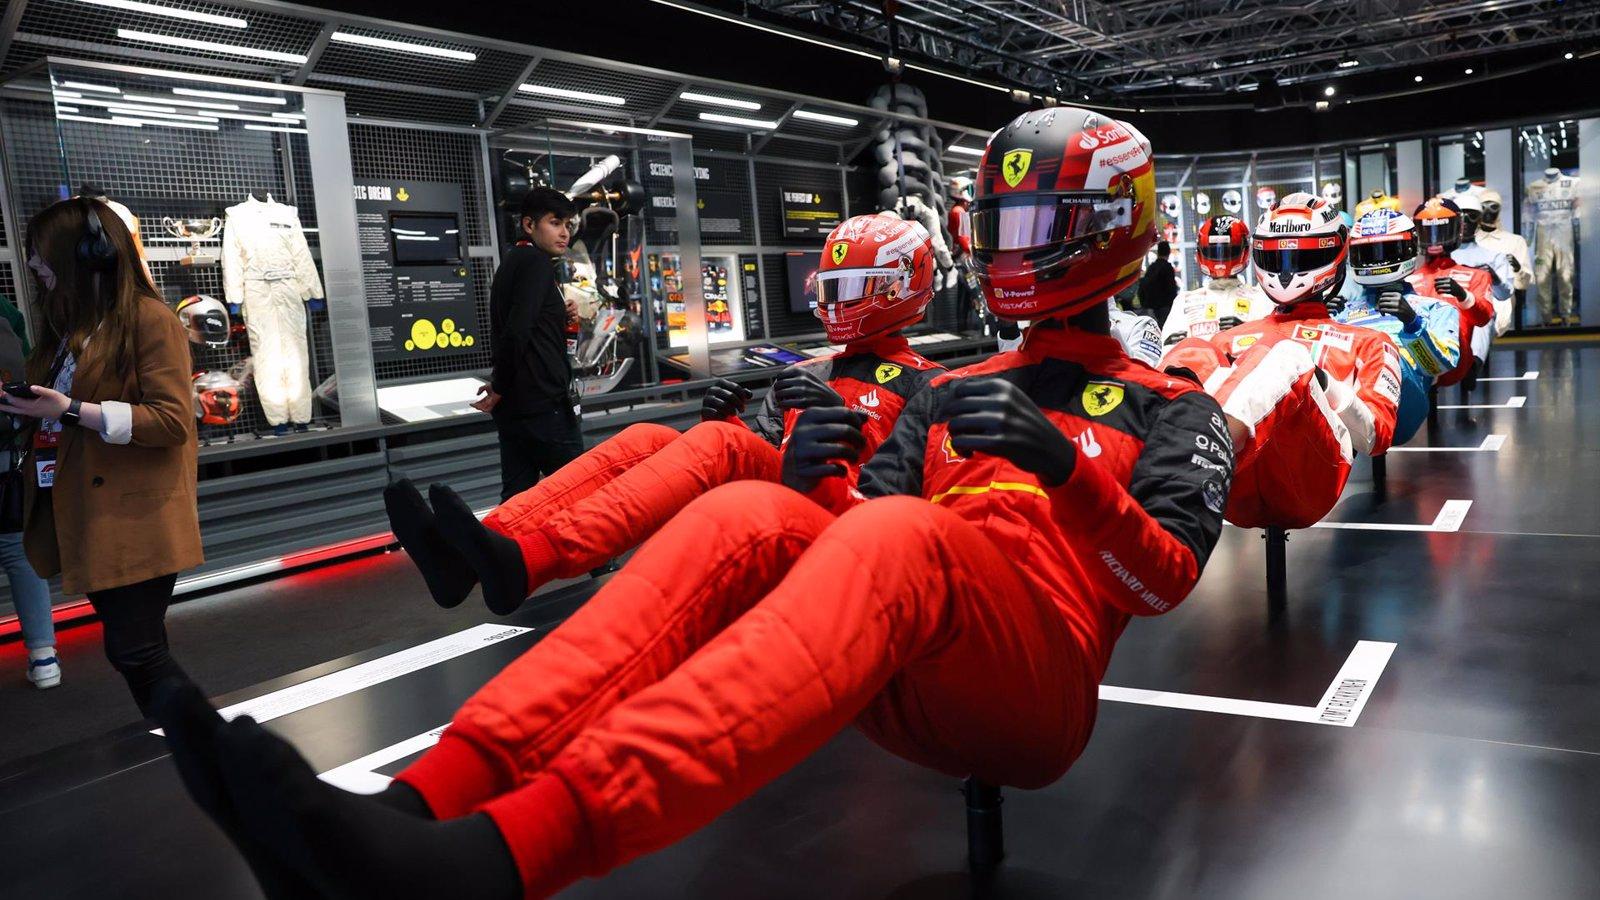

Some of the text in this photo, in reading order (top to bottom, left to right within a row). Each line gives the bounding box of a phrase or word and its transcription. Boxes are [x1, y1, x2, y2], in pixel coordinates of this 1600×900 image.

[650, 163, 673, 177] SCIENC
[1269, 219, 1311, 233] Marlboro
[1003, 290, 1035, 298] V-Power
[1099, 550, 1170, 612] RICHARD MILLE
